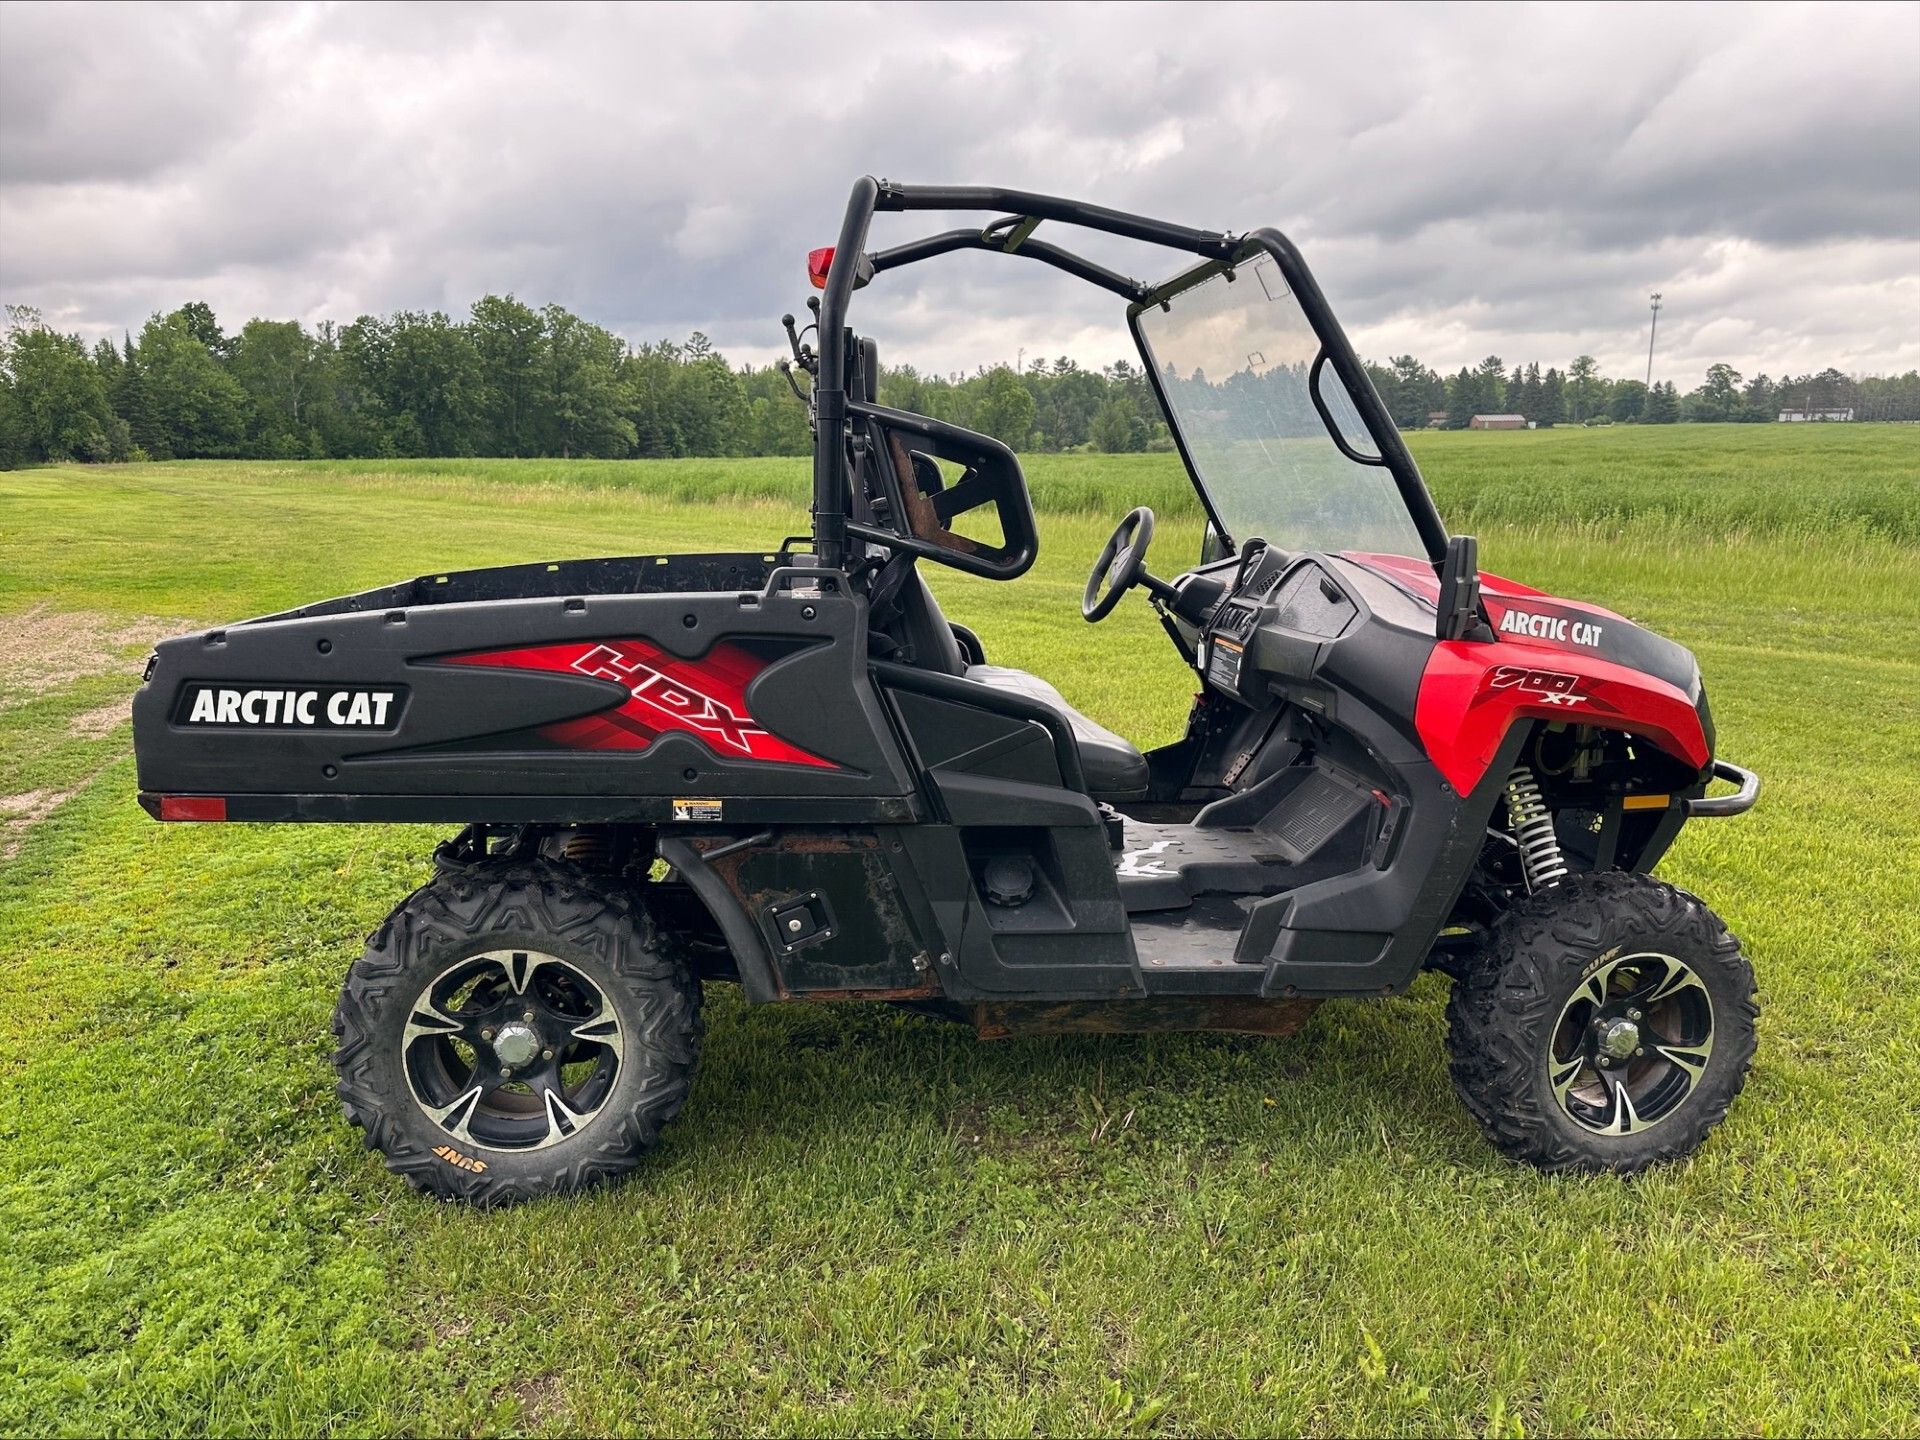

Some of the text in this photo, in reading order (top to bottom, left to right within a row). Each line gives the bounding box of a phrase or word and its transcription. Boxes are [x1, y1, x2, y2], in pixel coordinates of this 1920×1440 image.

[1499, 609, 1603, 647] ARCTIC CAT
[1490, 665, 1580, 694] 700
[189, 689, 394, 725] ARCTIC CAT
[570, 644, 769, 753] HDX
[1538, 693, 1588, 706] XT
[431, 1145, 489, 1173] SUNF
